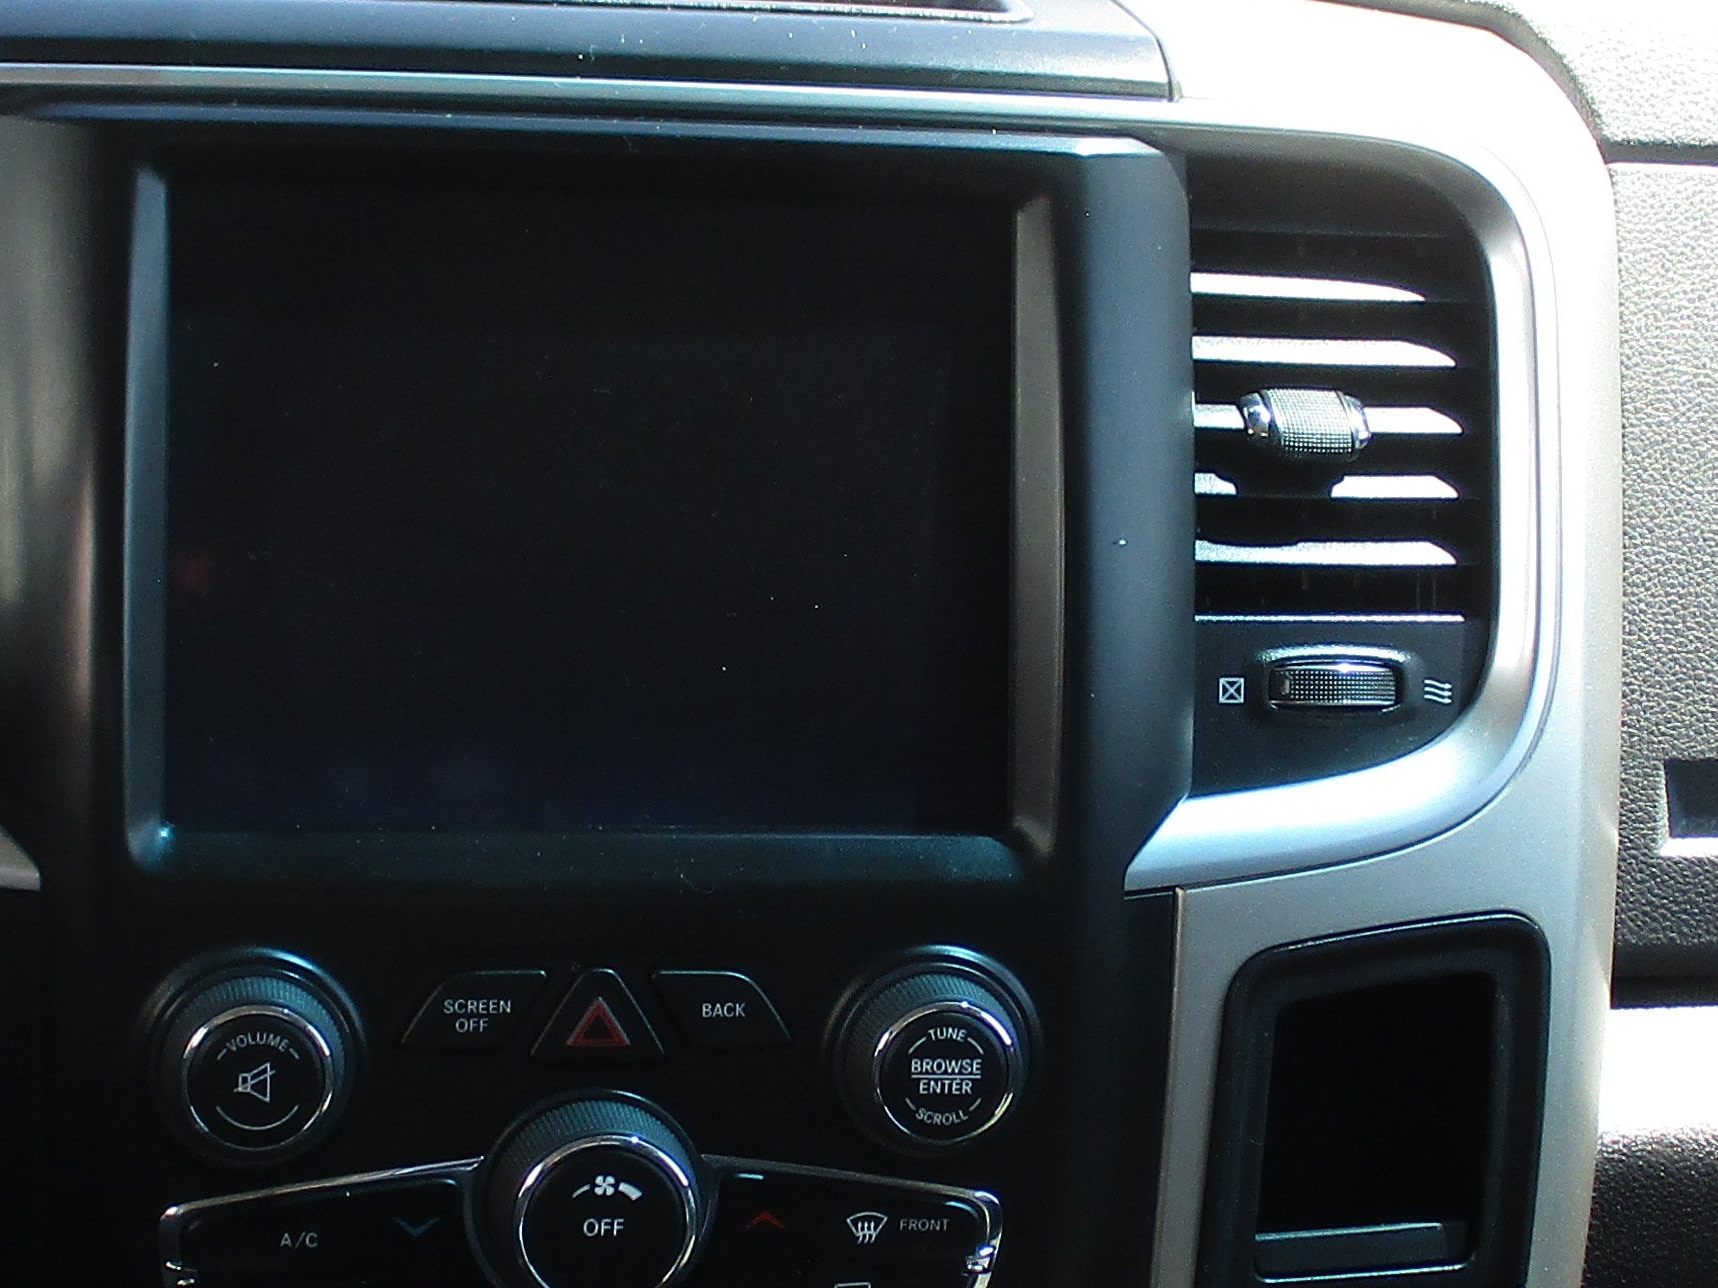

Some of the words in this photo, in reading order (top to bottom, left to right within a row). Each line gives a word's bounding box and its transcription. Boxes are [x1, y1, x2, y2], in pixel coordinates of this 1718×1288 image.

[443, 998, 512, 1014] SCREEN
[702, 1002, 745, 1018] BACK
[455, 1017, 488, 1033] OFF
[927, 1026, 967, 1042] TUNE
[226, 1032, 291, 1053] VOLUME
[910, 1058, 982, 1073] BROWSE
[918, 1079, 973, 1095] ENTER
[915, 1107, 969, 1126] SCROLL
[583, 1218, 624, 1237] OFF
[899, 1218, 949, 1232] FRONT
[280, 1231, 318, 1248] A/C
